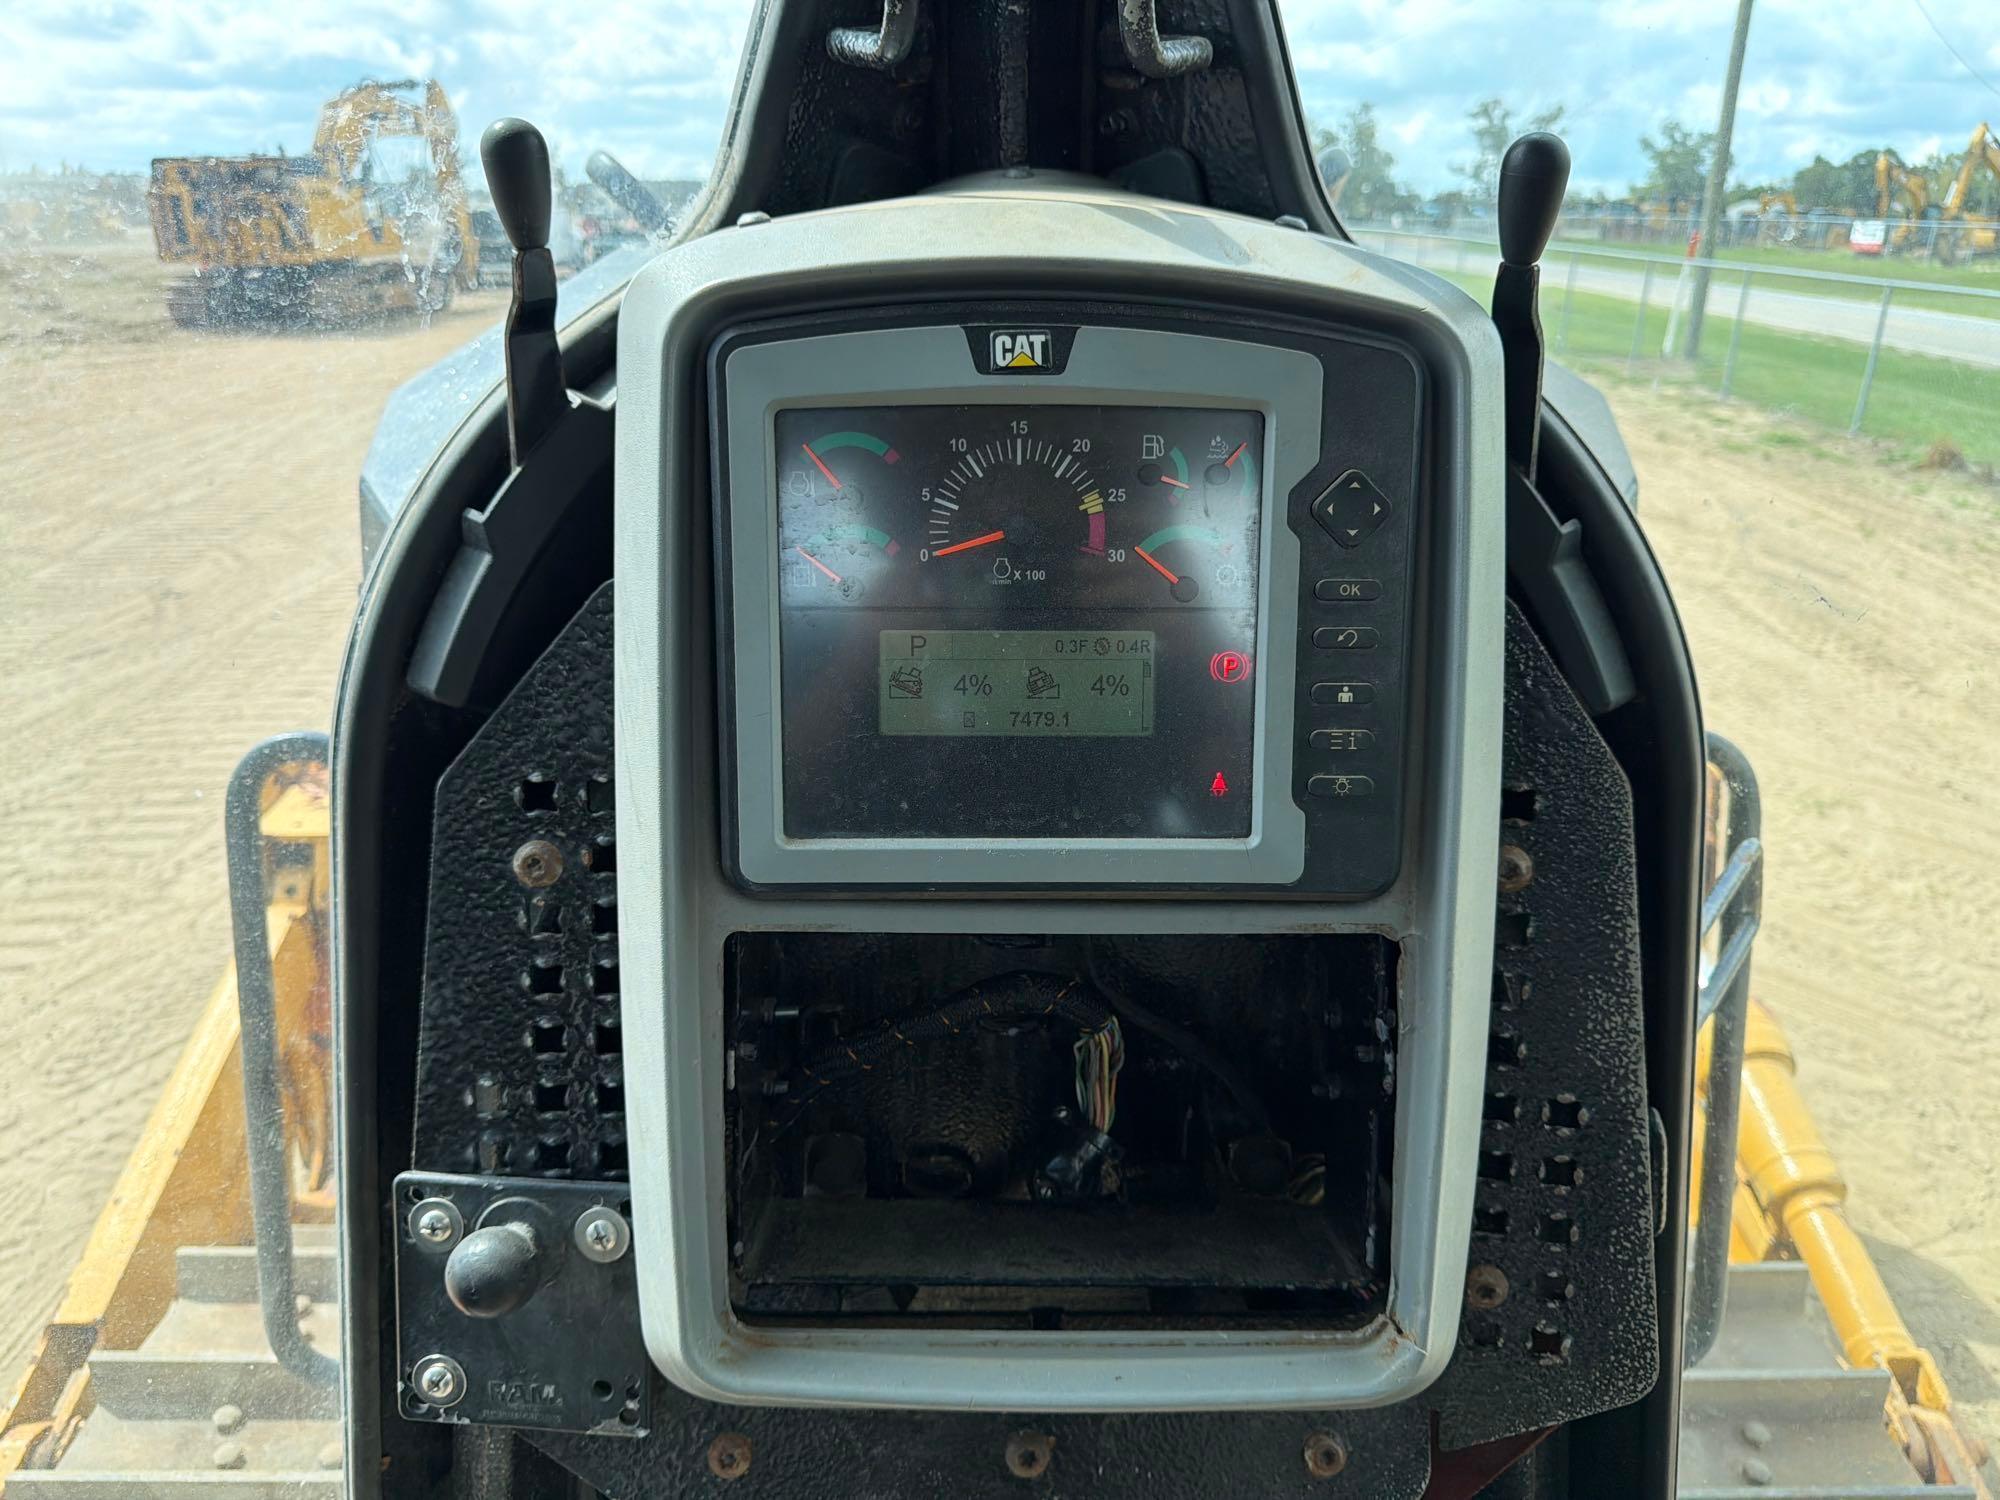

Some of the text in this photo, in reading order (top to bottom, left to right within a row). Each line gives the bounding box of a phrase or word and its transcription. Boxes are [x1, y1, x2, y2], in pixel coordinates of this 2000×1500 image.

[995, 334, 1046, 367] CAT
[1010, 420, 1028, 435] 15
[949, 438, 967, 452] 10
[1072, 438, 1091, 453] 20
[921, 488, 930, 502] 5
[1108, 488, 1127, 502] 25
[919, 549, 929, 563] 0
[1108, 549, 1126, 563] 30
[1025, 570, 1046, 580] 100
[1340, 584, 1361, 596] OK
[910, 635, 927, 656] P
[1054, 639, 1088, 654] 0.3F
[1115, 639, 1151, 654] 0.4R
[1223, 656, 1239, 680] P
[953, 673, 993, 697] 4%
[1090, 673, 1129, 697] 4%
[1009, 711, 1070, 728] 7479.1
